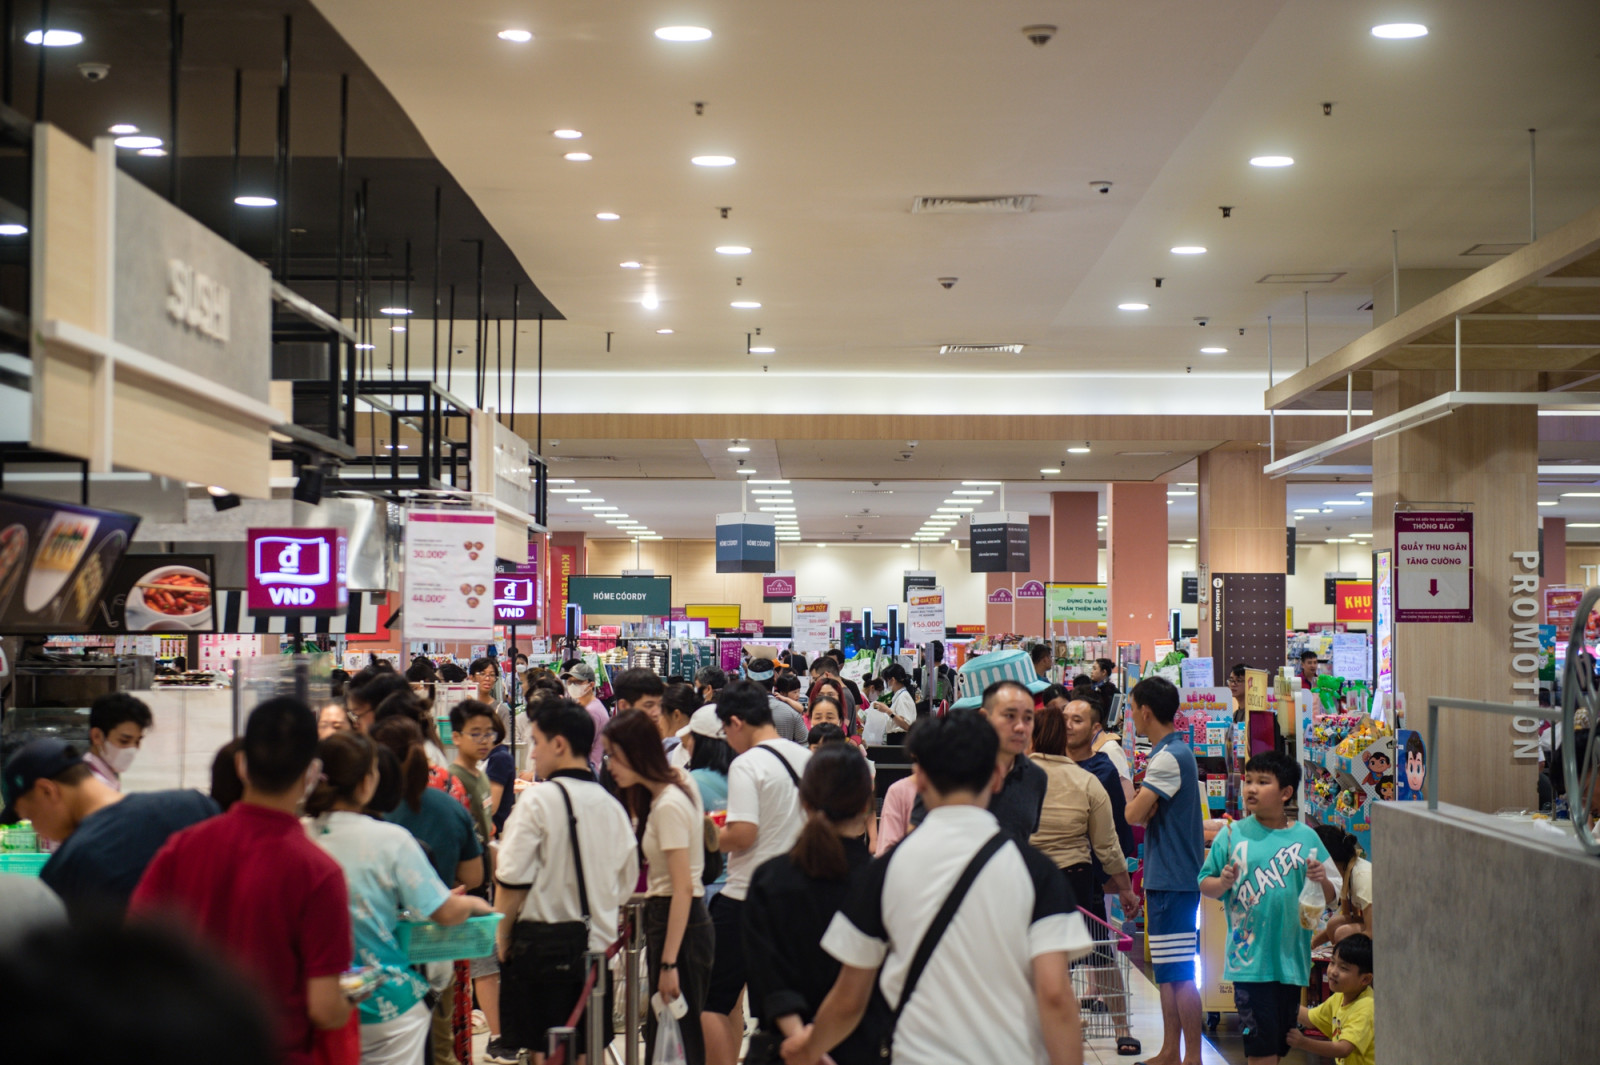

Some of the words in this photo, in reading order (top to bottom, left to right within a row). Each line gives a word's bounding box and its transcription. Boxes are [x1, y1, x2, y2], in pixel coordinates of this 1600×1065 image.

[1413, 522, 1437, 530] THÔNG
[1439, 522, 1455, 530] BÁO
[1443, 542, 1467, 551] NGÂN
[1406, 557, 1429, 565] TĂNG
[1431, 556, 1461, 565] CƯỜNG
[268, 587, 316, 606] VND
[593, 591, 614, 600] HÓME
[616, 591, 646, 600] CÓORDY
[1344, 595, 1372, 609] KHU
[498, 607, 525, 618] VND
[1187, 691, 1198, 702] LỄ
[1199, 692, 1216, 702] HỘI
[1237, 842, 1305, 912] PLAYER
